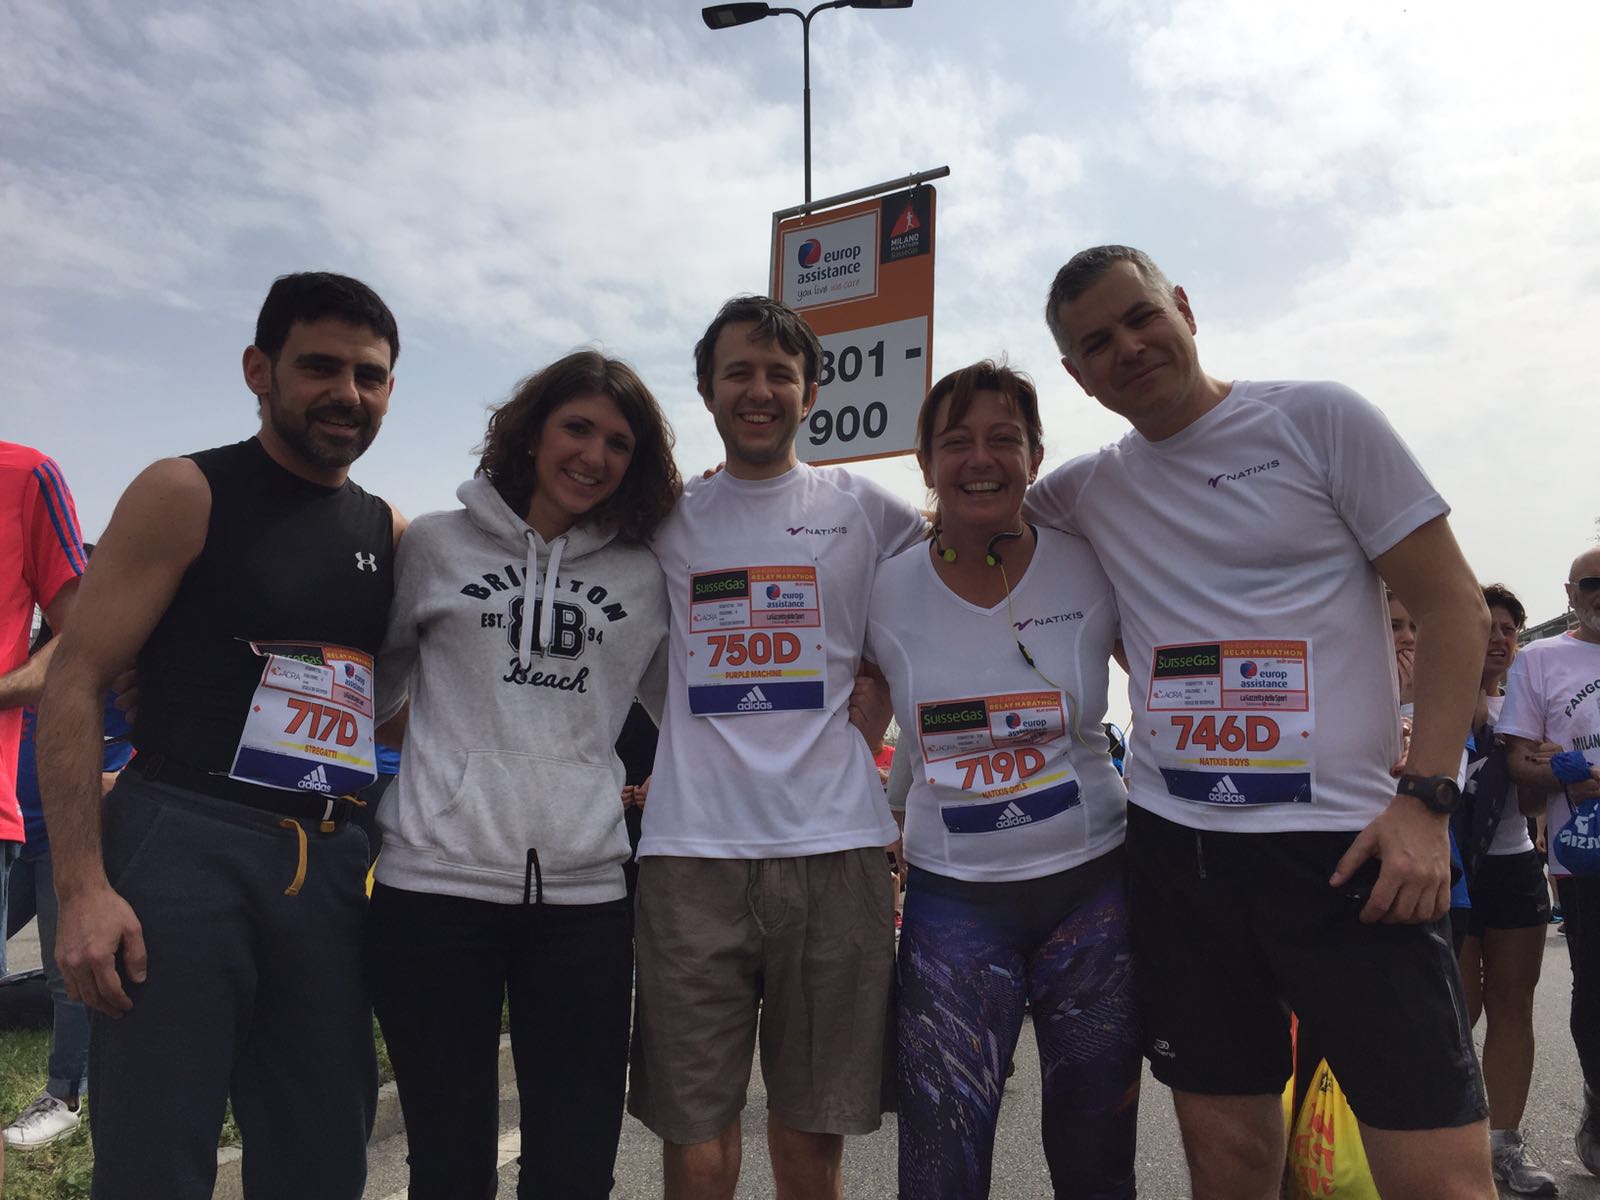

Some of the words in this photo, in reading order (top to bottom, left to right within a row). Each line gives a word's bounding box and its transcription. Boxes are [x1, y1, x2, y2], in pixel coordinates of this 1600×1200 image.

[891, 233, 919, 246] MILANO
[823, 245, 861, 263] europ
[797, 262, 861, 284] assistance
[797, 289, 812, 302] you
[814, 285, 828, 295] live
[809, 401, 888, 445] 900
[1227, 460, 1280, 480] NATIXIS
[805, 526, 848, 536] NATIXIS
[460, 564, 628, 622] BRITON
[695, 579, 745, 594] SuisseGas
[766, 600, 805, 608] assistance
[782, 592, 804, 601] europ
[480, 612, 506, 629] EST.
[1034, 611, 1084, 626] NATIXIS
[587, 627, 603, 645] 94
[707, 632, 801, 667] 750D
[1157, 655, 1216, 669] SuisseGas
[503, 657, 590, 693] Beach
[725, 670, 750, 679] PURPLE
[750, 669, 783, 678] MACHINE
[1260, 671, 1287, 679] europ
[1240, 679, 1288, 688] assistance
[737, 701, 773, 711] adidas
[989, 702, 1013, 711] RELAY
[1014, 698, 1059, 707] MARATHON
[284, 697, 359, 747] 717D
[923, 710, 983, 725] SuisseGas
[1022, 718, 1047, 728] europ
[1171, 715, 1281, 752] 746D
[304, 744, 337, 759] STREGATTI
[955, 748, 1046, 790] 719D
[1200, 758, 1228, 767] NATIXIS
[1229, 758, 1250, 767] BOYS
[297, 780, 332, 793] adidas
[1208, 792, 1246, 803] adidas
[995, 813, 1032, 829] adidas
